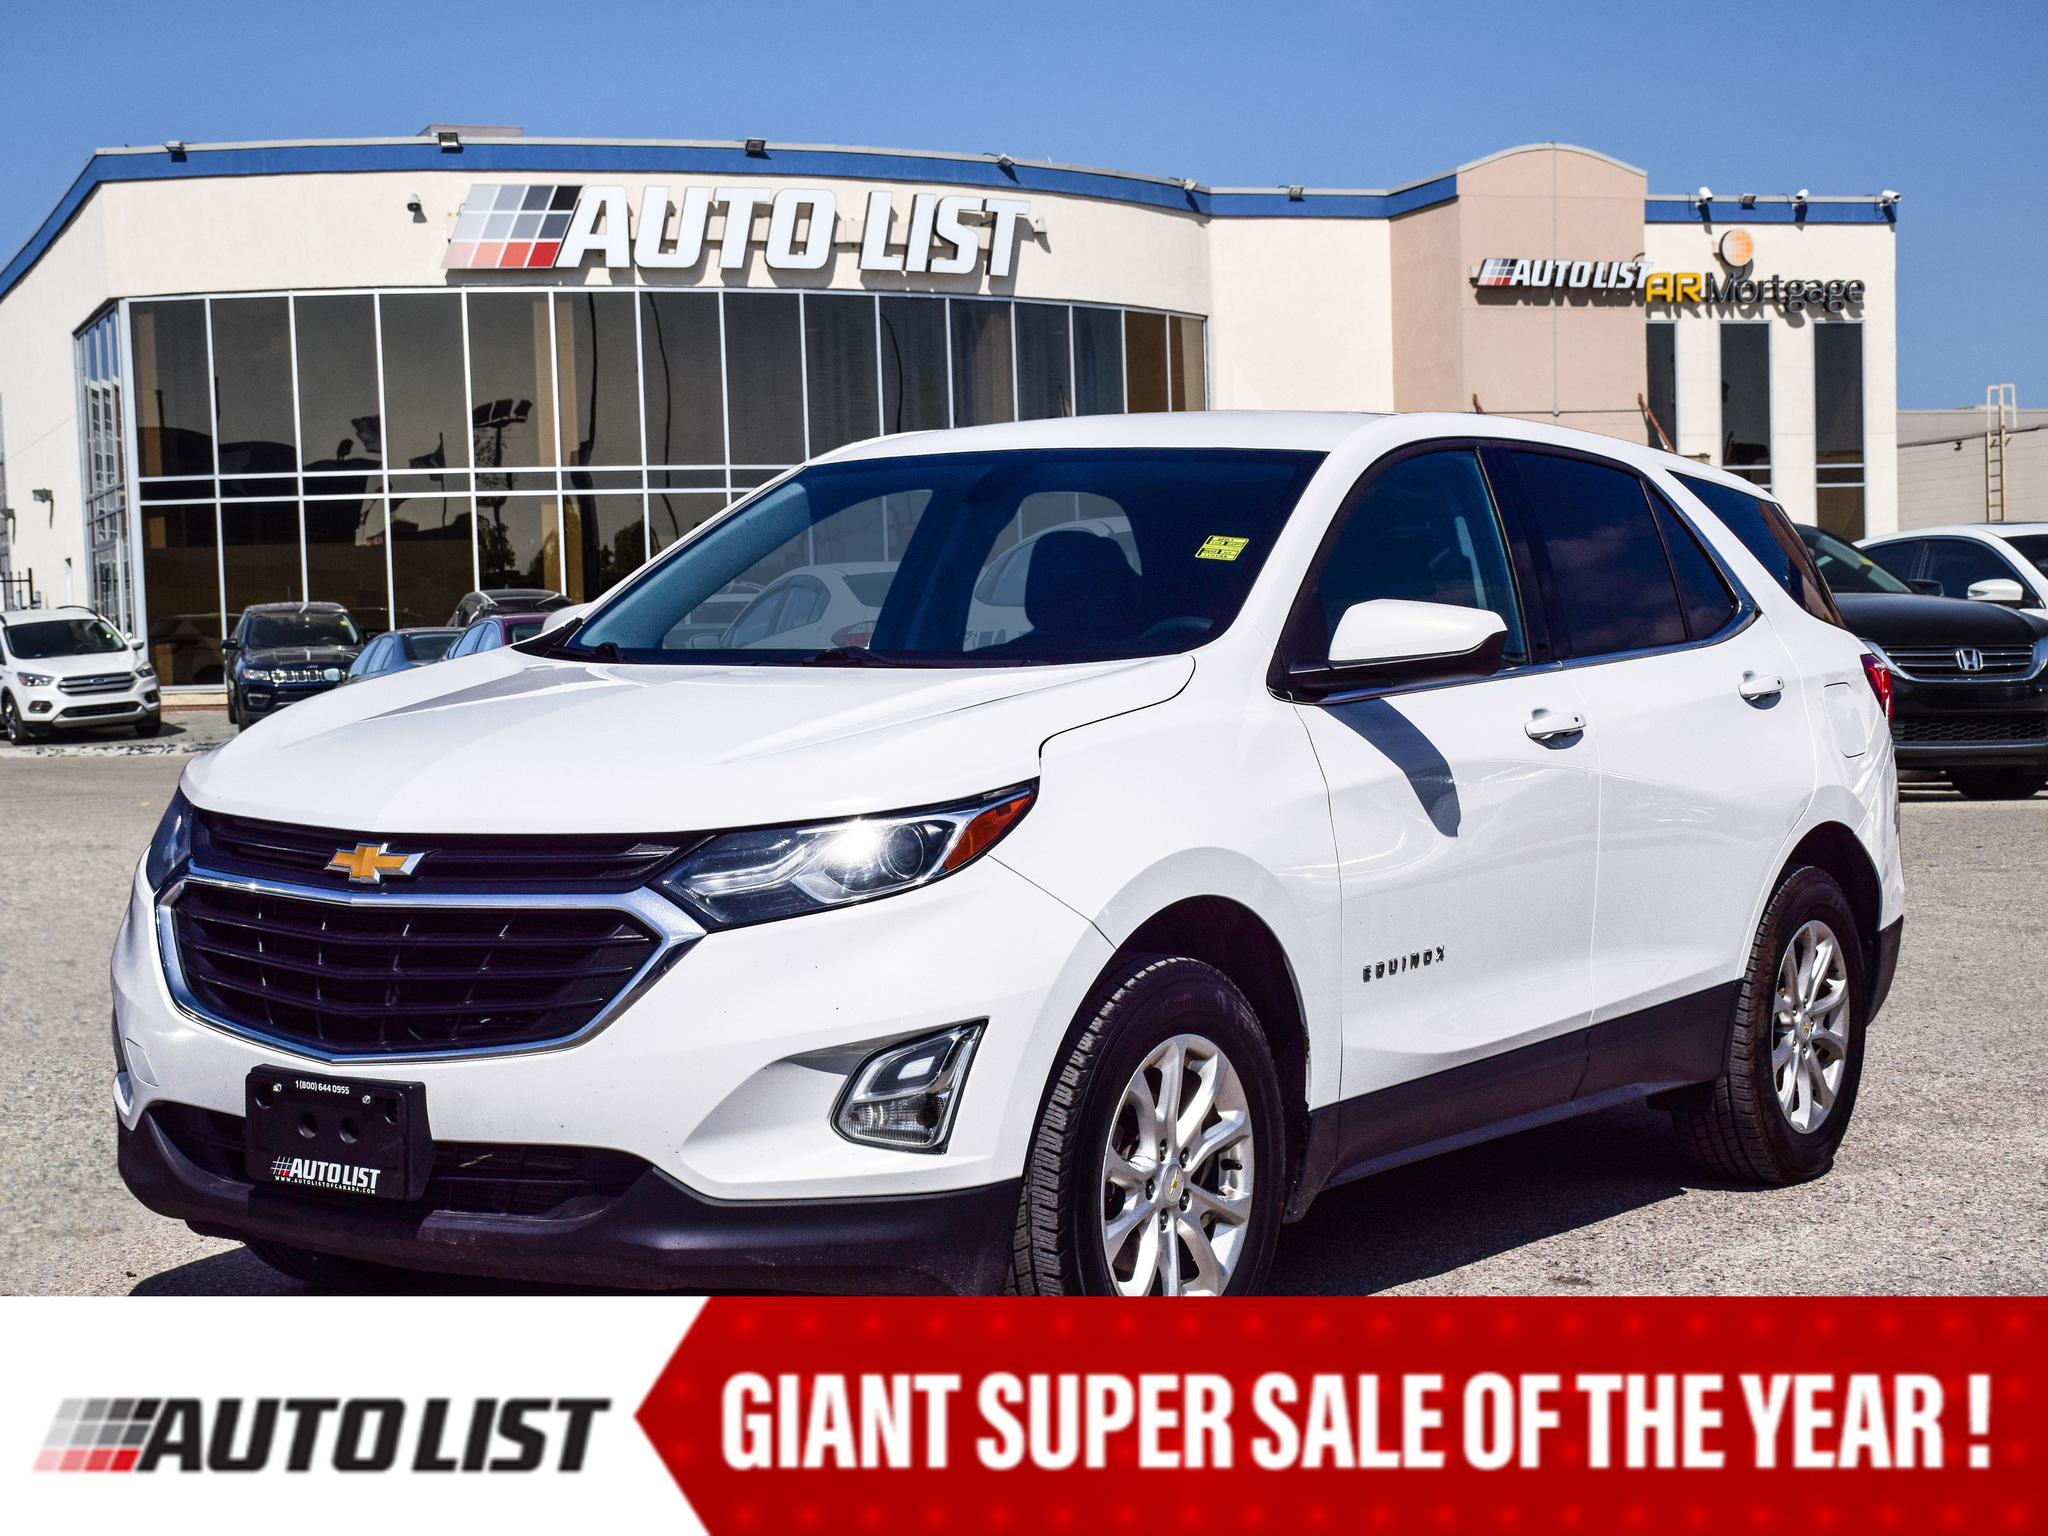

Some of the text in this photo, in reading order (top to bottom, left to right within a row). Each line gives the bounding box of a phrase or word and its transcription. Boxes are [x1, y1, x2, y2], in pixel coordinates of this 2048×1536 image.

[556, 185, 1030, 277] AUTO LIST
[1510, 259, 1653, 289] AUTO LIST
[1645, 272, 1865, 313] AR Mortgage
[1363, 945, 1444, 982] EQUINOX
[318, 1083, 331, 1092] 644
[332, 1085, 349, 1094] 0955
[289, 1158, 380, 1189] AUTO LIST
